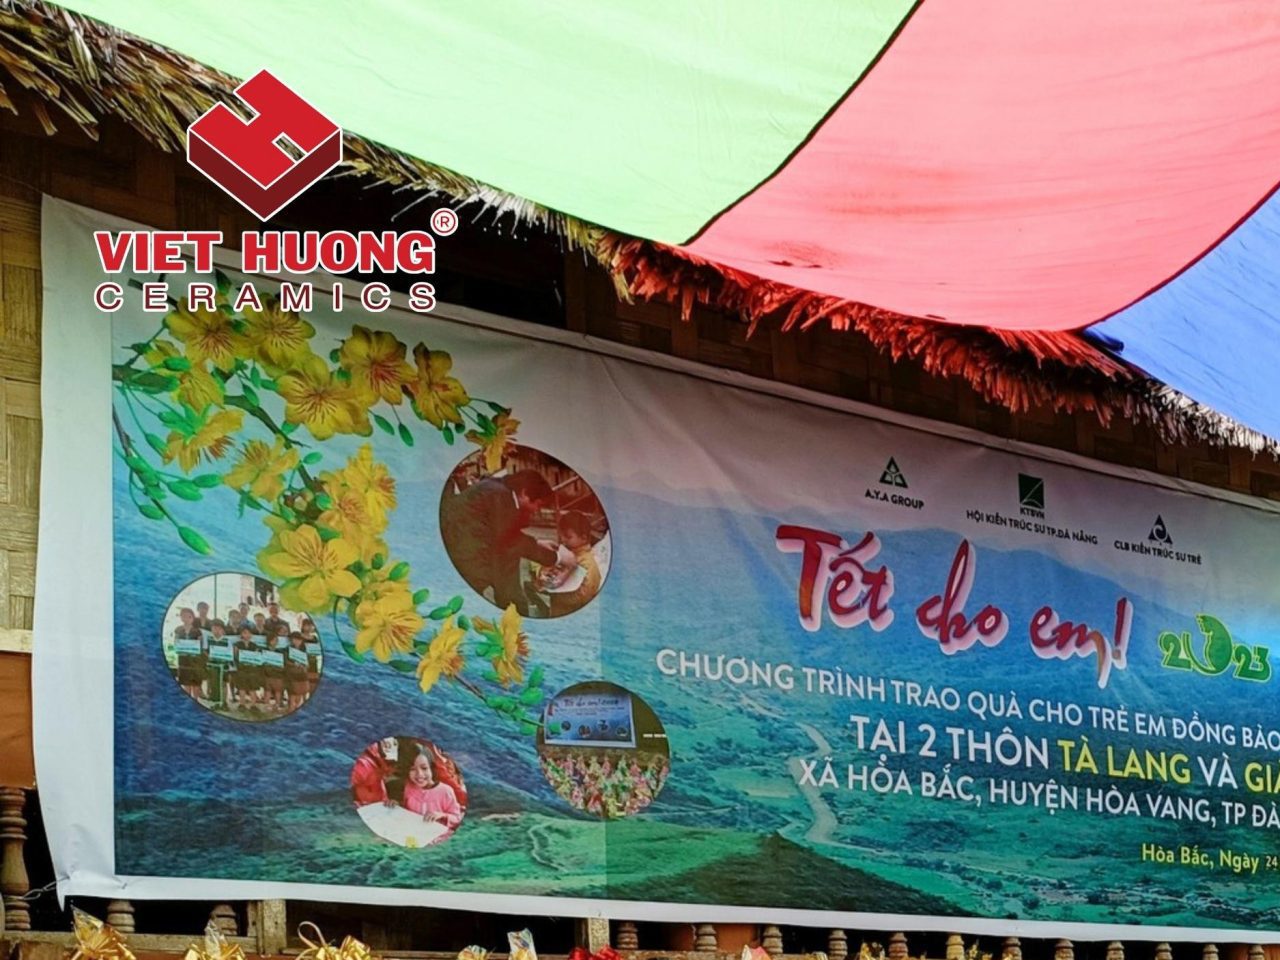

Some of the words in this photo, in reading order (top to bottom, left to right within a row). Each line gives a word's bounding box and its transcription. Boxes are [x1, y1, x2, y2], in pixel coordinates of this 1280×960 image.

[891, 494, 924, 510] GROUP
[777, 524, 894, 633] Tết
[916, 539, 1008, 655] cho
[1030, 597, 1133, 688] em!
[1158, 613, 1273, 682] 2023
[656, 648, 794, 690] CHƯƠNG
[802, 667, 885, 702] TRÌNH
[891, 680, 961, 711] TRAO
[967, 690, 1023, 721] QUÀ
[1029, 698, 1082, 726] CHO
[1088, 704, 1130, 733] TRẺ
[1135, 712, 1167, 738] EM
[1172, 710, 1236, 746] ĐỒNG
[850, 714, 906, 762] TẠI
[918, 723, 937, 758] 2
[946, 726, 1049, 770] THÔN
[1057, 734, 1098, 775] TÀ
[1107, 745, 1191, 784] LANG
[1197, 751, 1238, 789] VÀ
[799, 756, 839, 789] XÃ
[921, 763, 982, 807] BẮC,
[990, 778, 1078, 816] HUYỆN
[1087, 784, 1141, 816] HÒA
[1146, 793, 1217, 827] VANG,
[1221, 800, 1246, 825] TP
[1142, 843, 1175, 863] Hòa
[1180, 844, 1214, 870] Bắc,
[1219, 849, 1259, 874] Ngày
